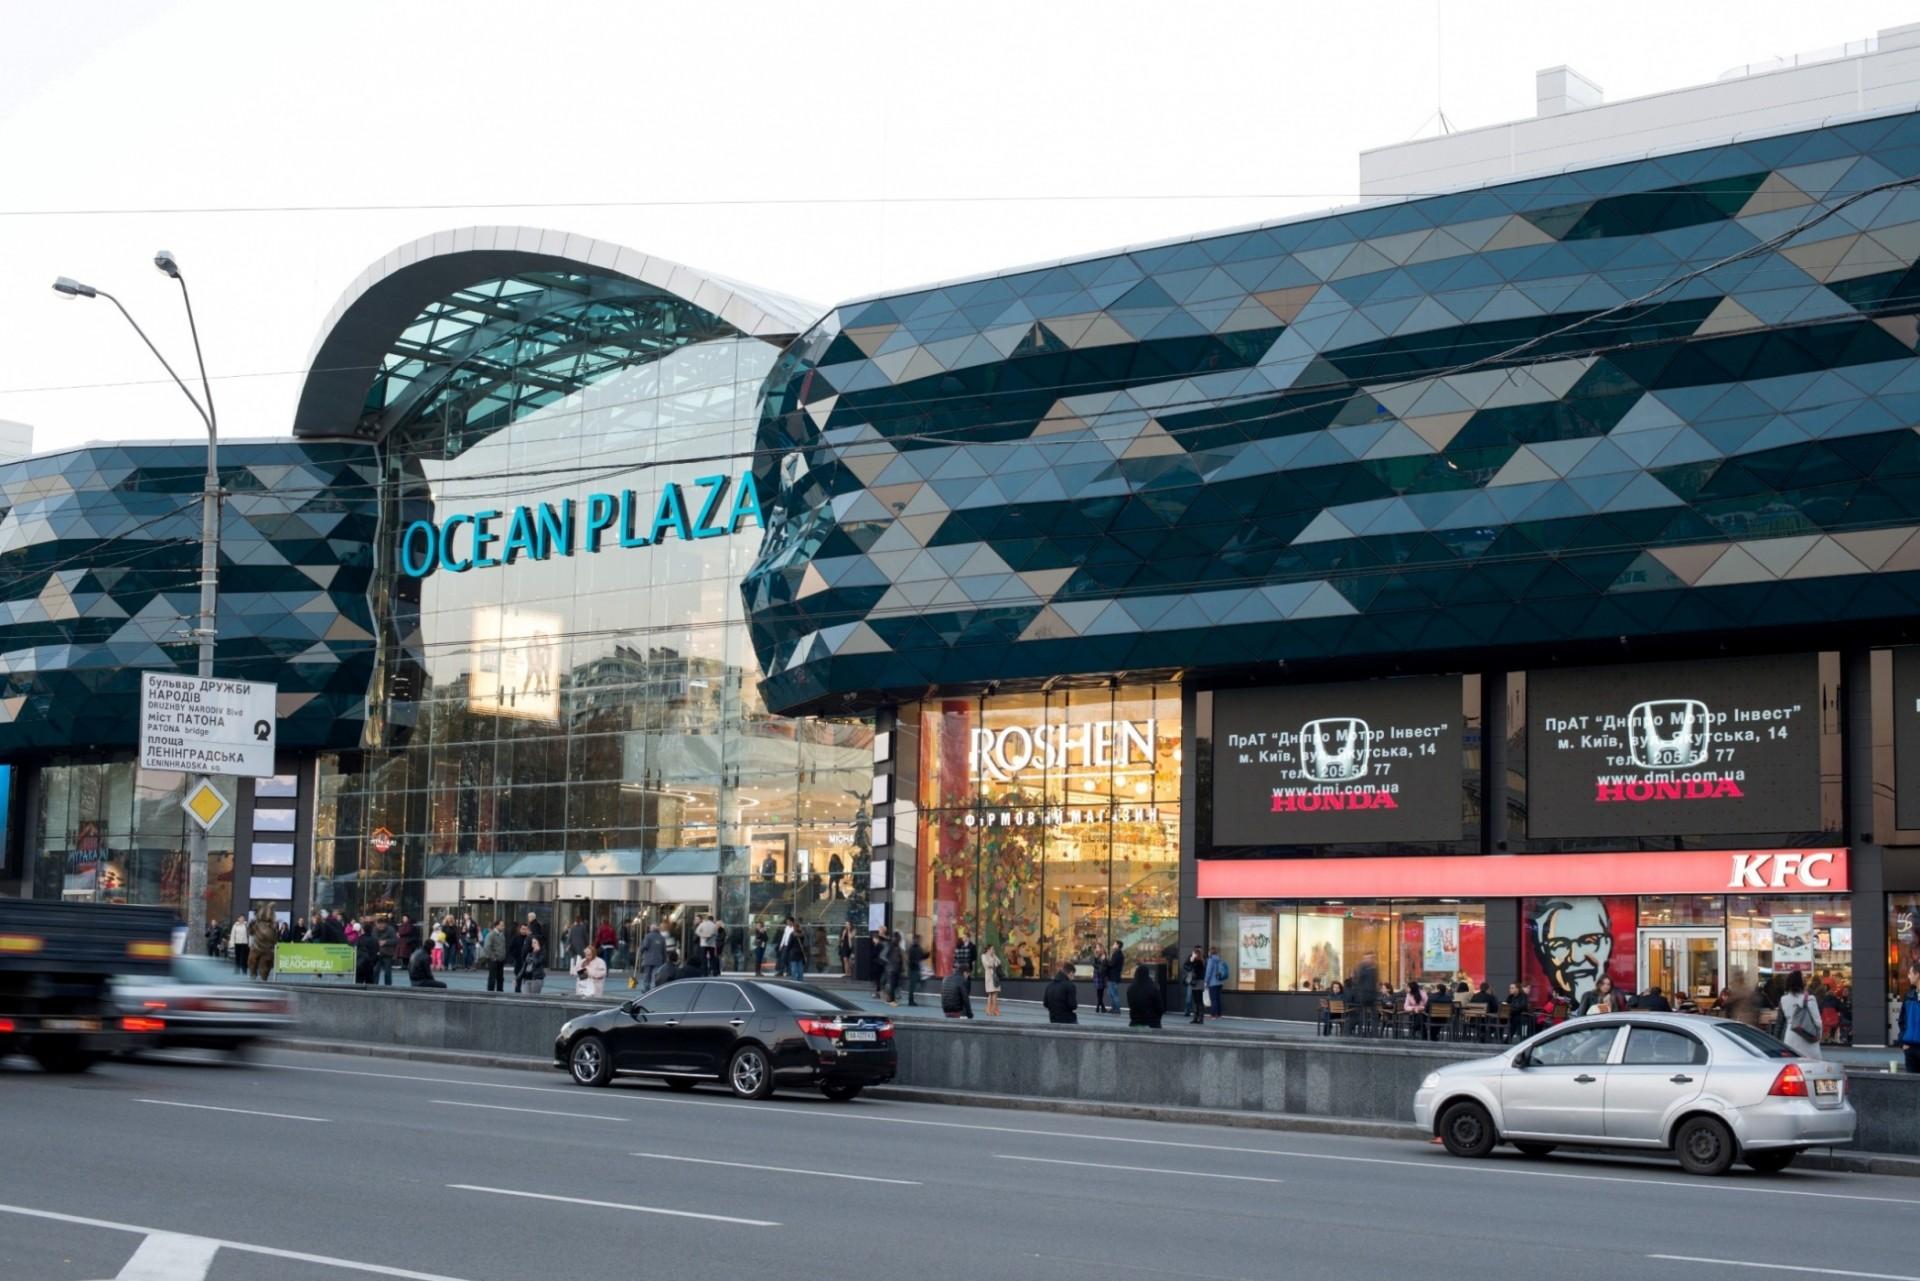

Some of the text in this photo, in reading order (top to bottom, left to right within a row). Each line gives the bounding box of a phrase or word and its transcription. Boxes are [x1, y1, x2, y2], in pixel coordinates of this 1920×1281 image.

[402, 470, 766, 578] OCEAN PLAZA
[148, 676, 251, 695] бульвар ДРУЖБИ
[149, 689, 201, 703] НАРОДІВ
[148, 701, 185, 711] DRUZHBY
[188, 705, 223, 714] NARODIV
[148, 711, 225, 727] міст ПАТОНА
[1545, 716, 1589, 732] ПрАТ
[147, 723, 209, 736] PATONA bridge
[1581, 734, 1624, 749] Київ,
[1767, 725, 1788, 740] 14
[148, 735, 184, 746] площа
[1228, 733, 1267, 748] ПрАТ
[147, 746, 245, 763] ЛЕНІНГРАДСЬКА
[969, 718, 1155, 781] ROSHEN
[1259, 750, 1296, 764] Київ,
[1418, 742, 1437, 756] 14
[1714, 748, 1736, 761] 77
[147, 759, 208, 770] LENINHRADSKA
[1373, 763, 1391, 775] 77
[1597, 770, 1745, 785] www.dmi.com.ua
[1272, 783, 1400, 797] www.dmi.com.ua
[1595, 778, 1745, 802] HONDA
[1270, 790, 1399, 812] HONDA
[1727, 852, 1834, 888] KFC
